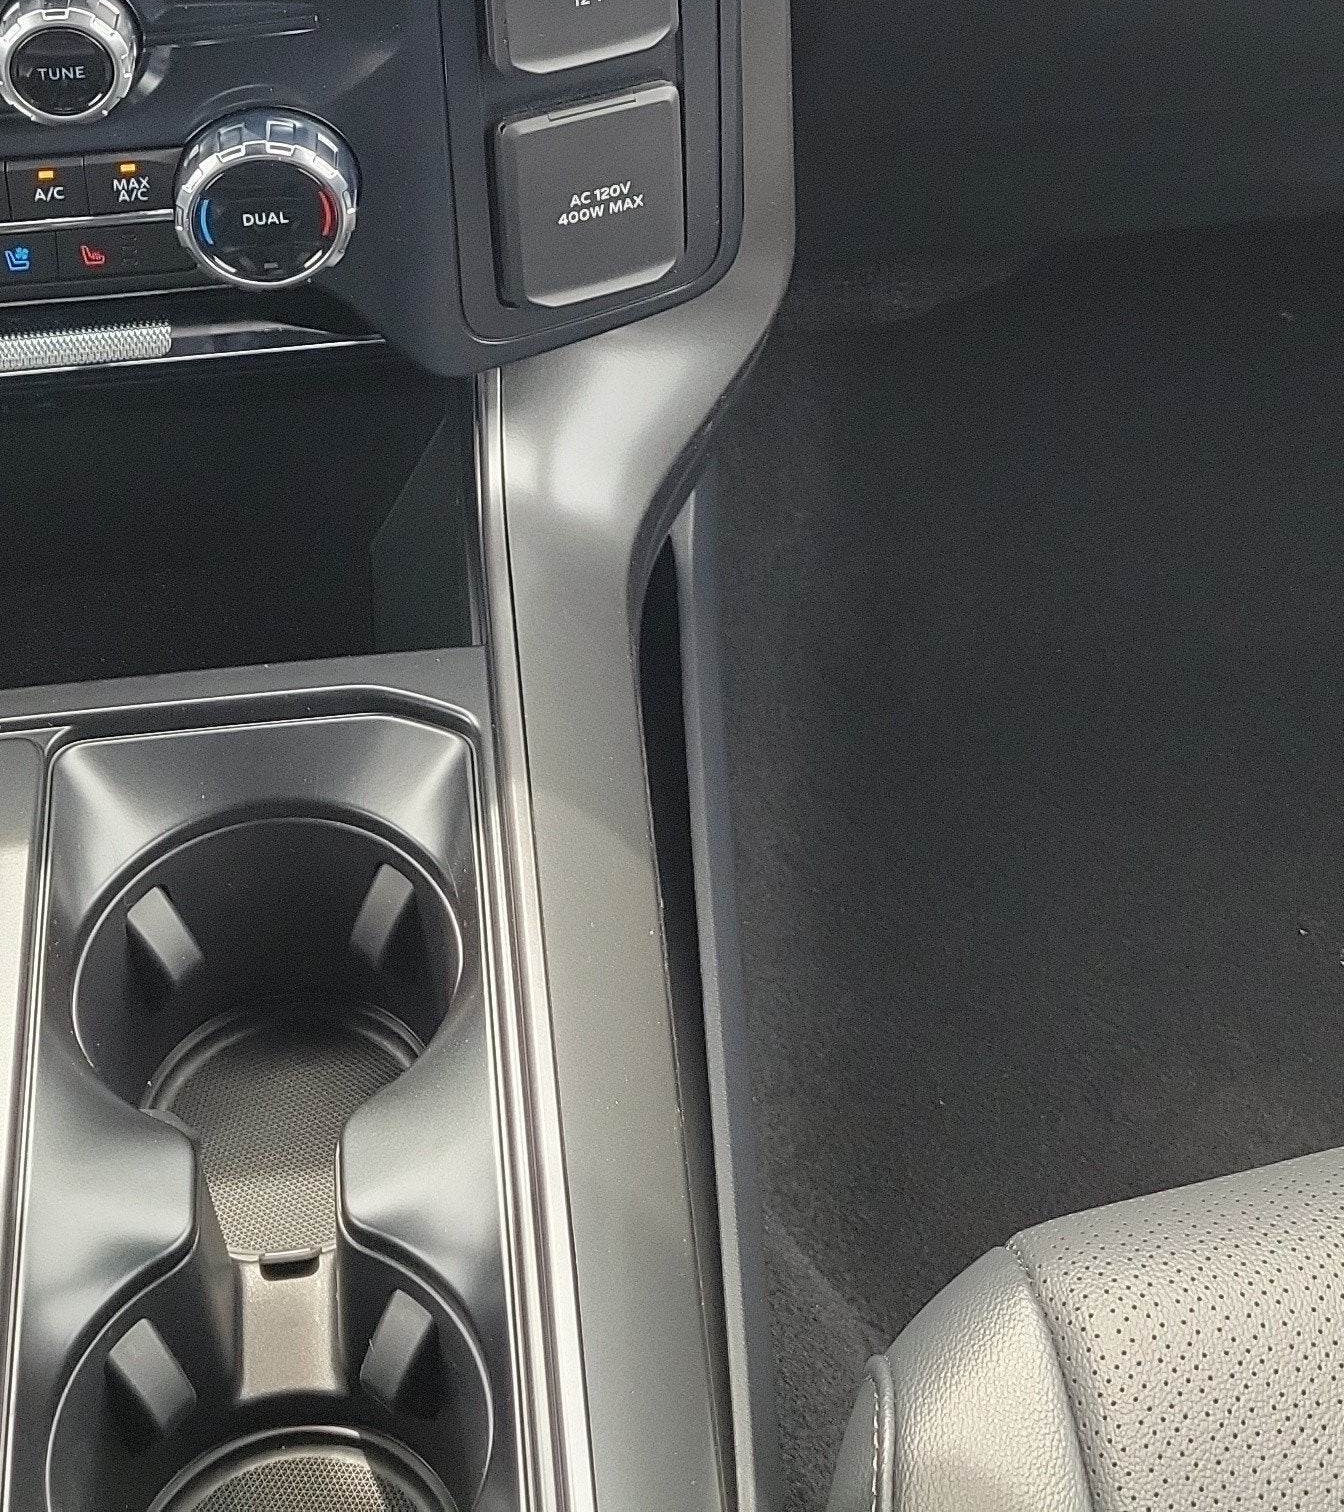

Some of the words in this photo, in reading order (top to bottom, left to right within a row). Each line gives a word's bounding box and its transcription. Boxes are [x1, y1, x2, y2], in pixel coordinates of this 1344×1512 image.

[37, 65, 86, 81] TUNE
[113, 176, 151, 192] MAX
[34, 186, 65, 203] A/C
[118, 188, 149, 203] A/C
[569, 191, 592, 208] AC
[593, 180, 632, 201] 120V
[558, 205, 605, 226] 400W
[609, 194, 644, 215] MAX
[242, 211, 290, 227] DUAL
